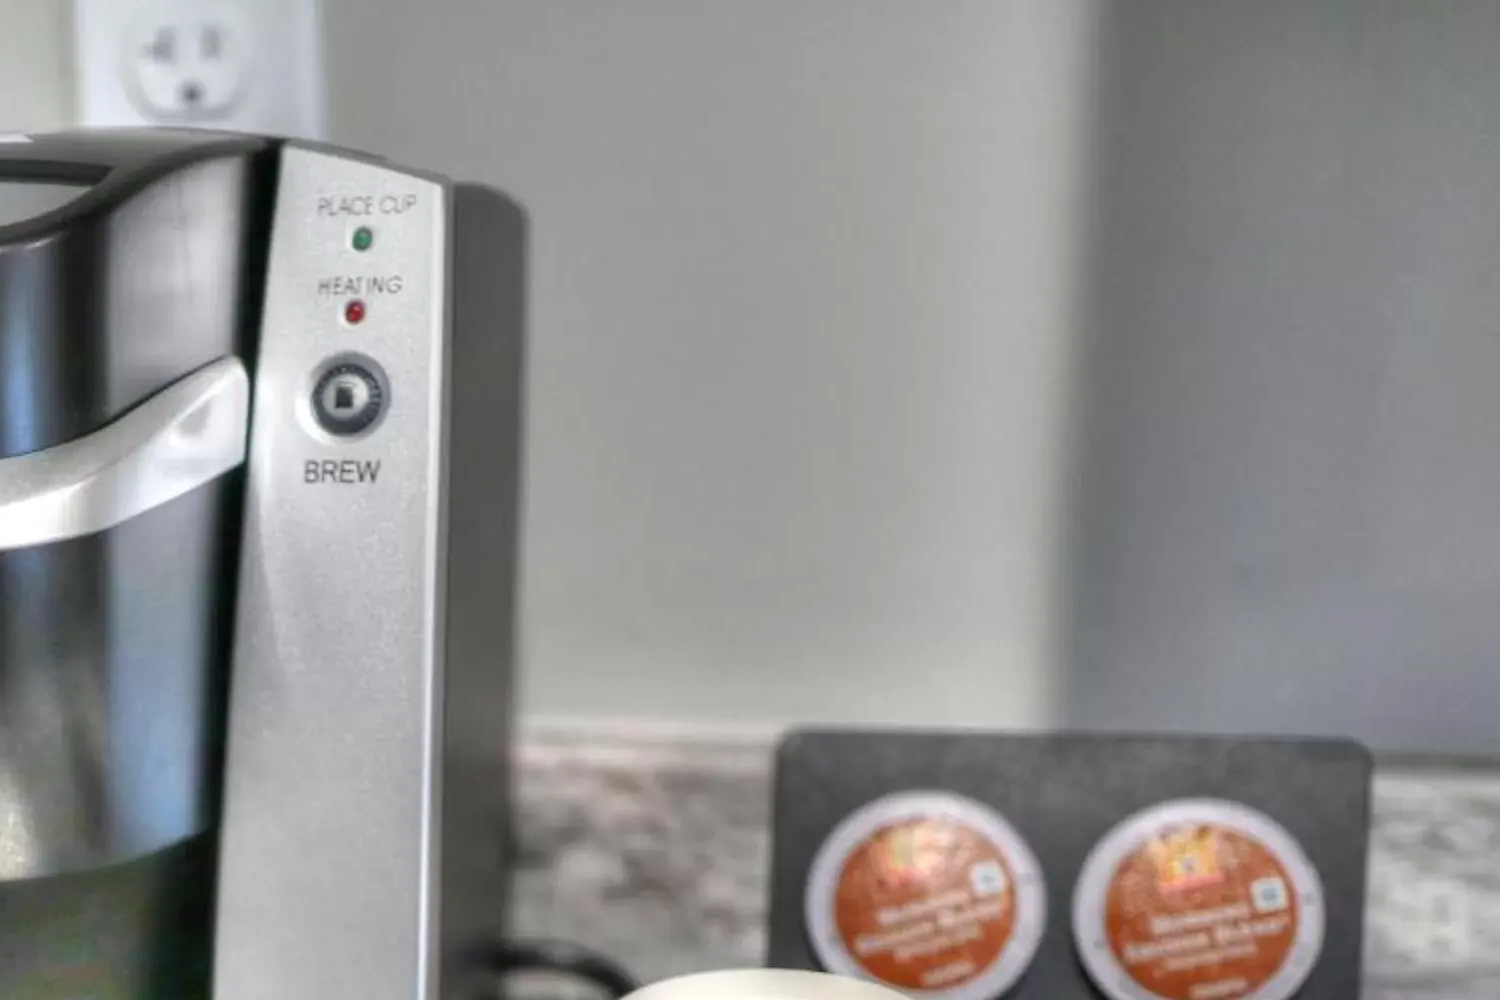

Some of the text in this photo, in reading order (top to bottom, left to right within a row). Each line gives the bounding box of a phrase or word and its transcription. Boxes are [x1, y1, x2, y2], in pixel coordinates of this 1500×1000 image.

[317, 193, 417, 216] PLACE CUP
[318, 274, 403, 298] HEATING
[304, 458, 381, 484] BREW
